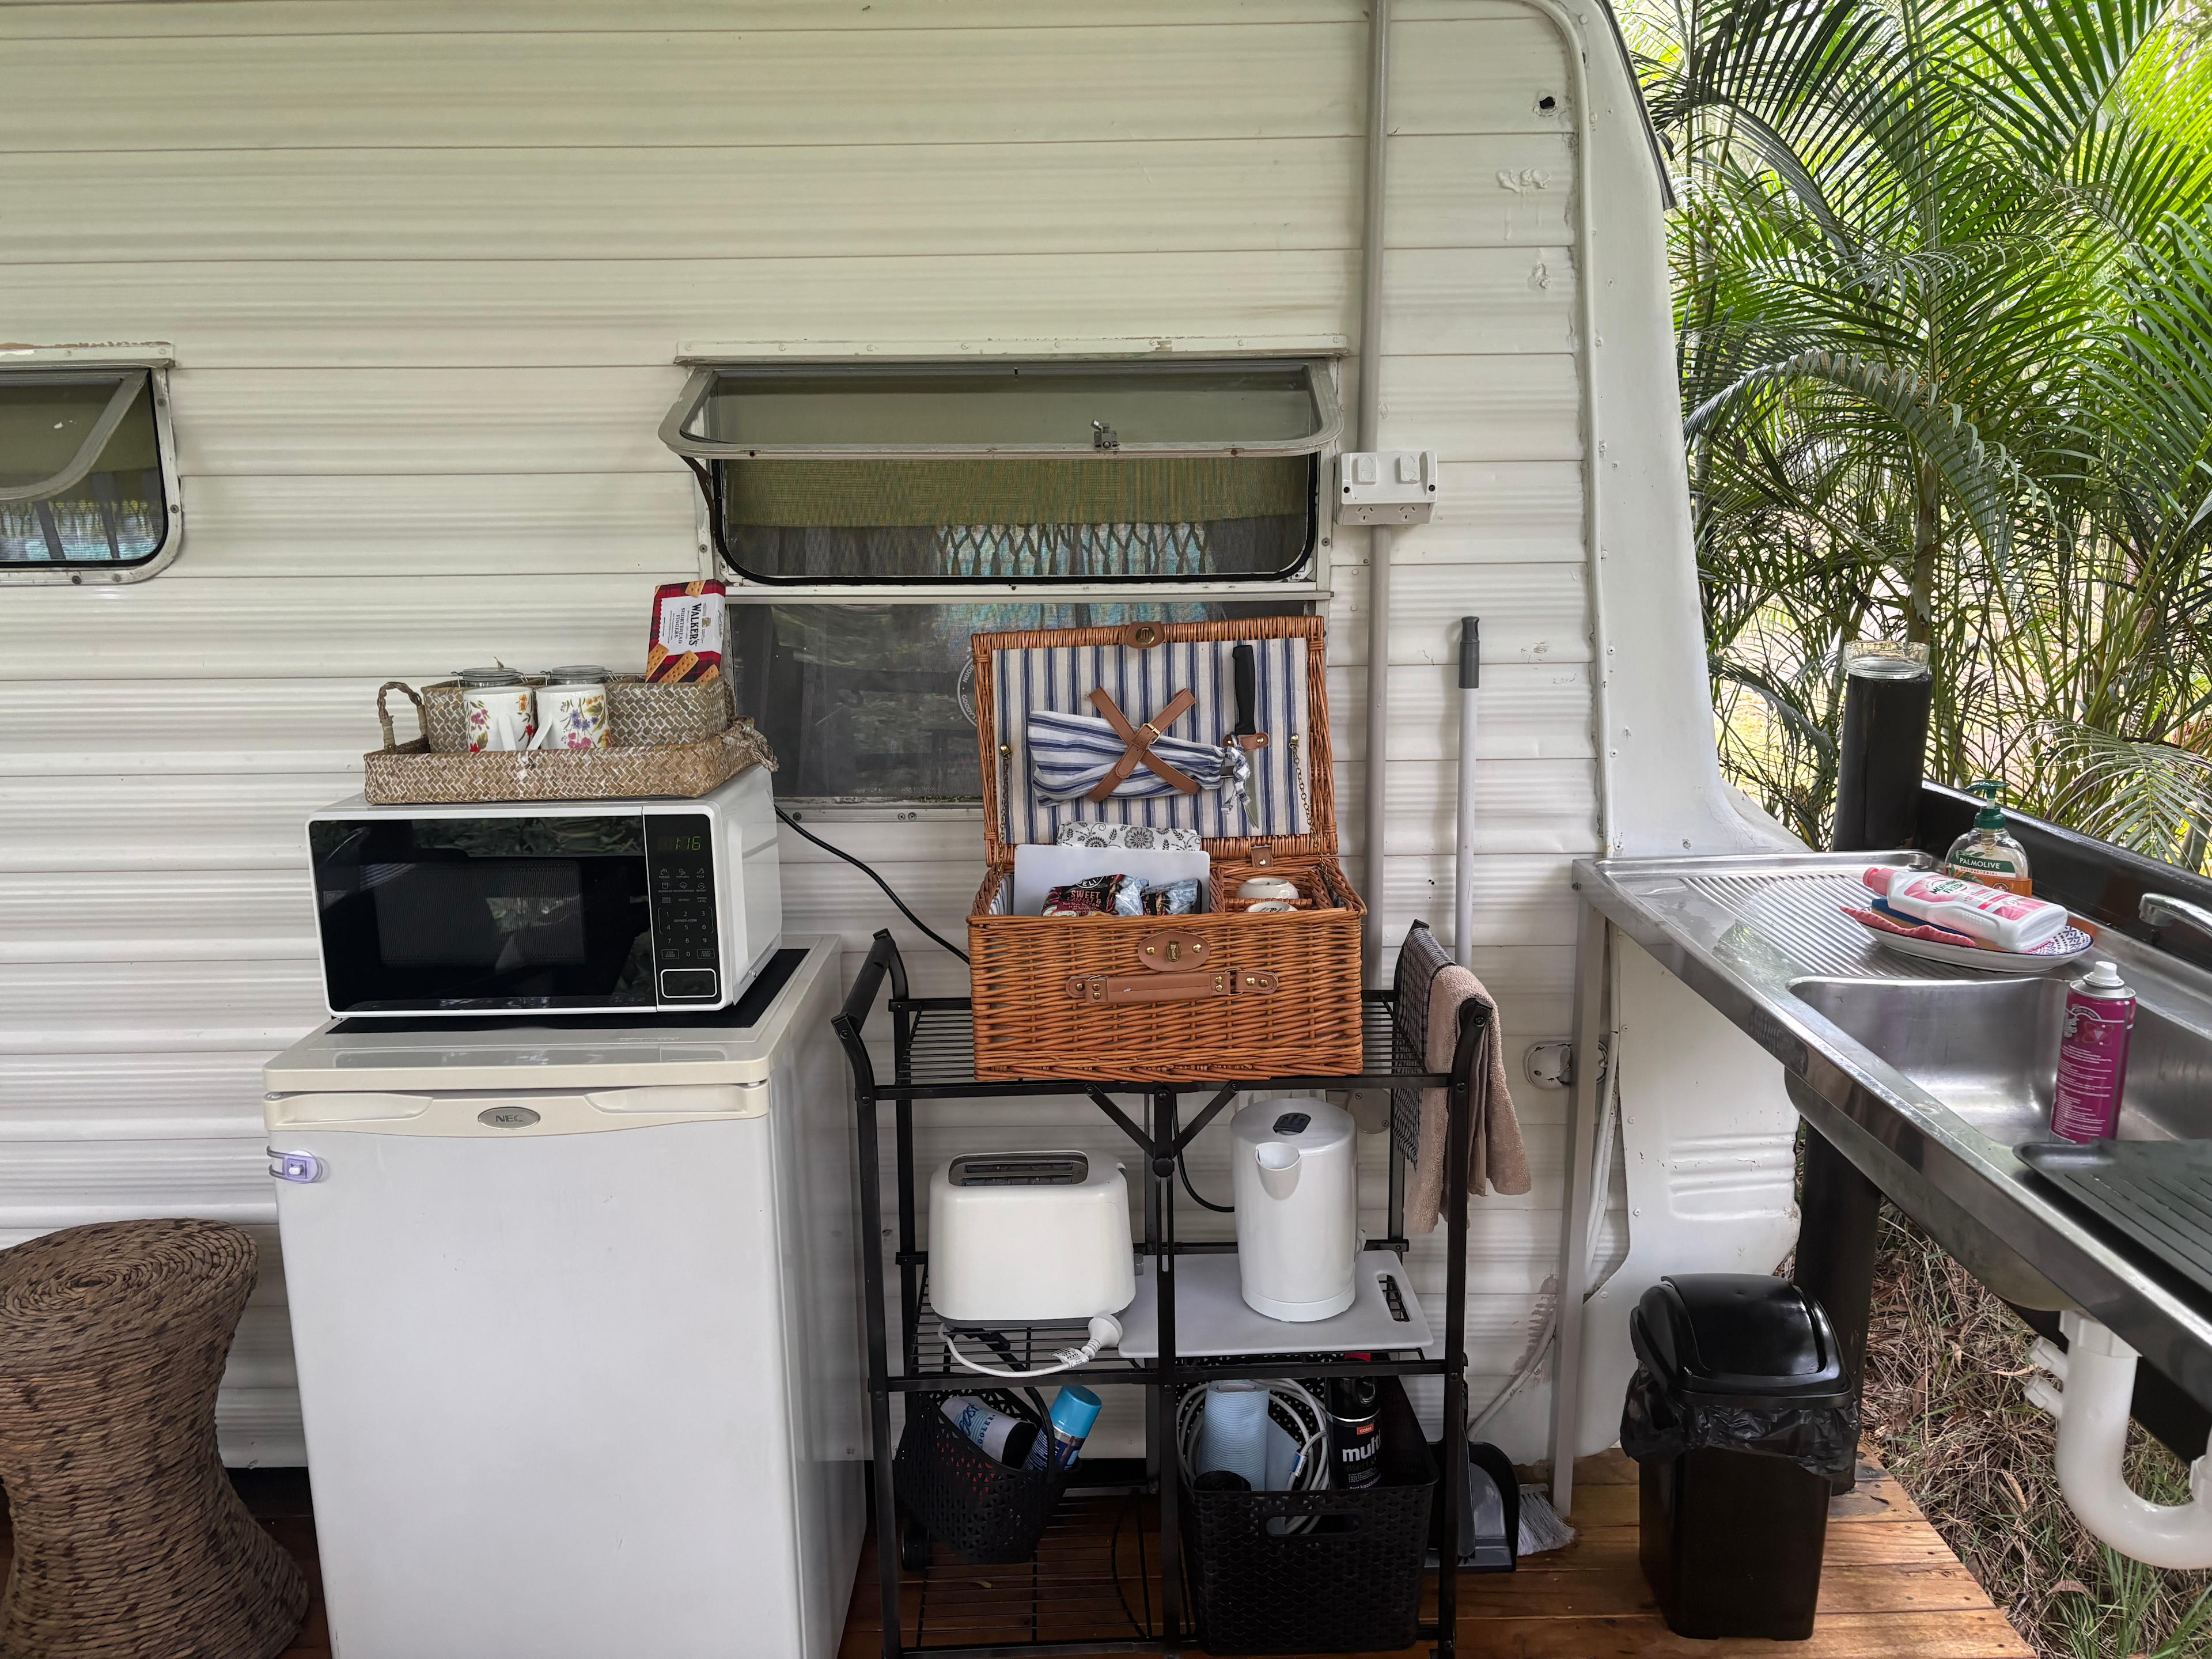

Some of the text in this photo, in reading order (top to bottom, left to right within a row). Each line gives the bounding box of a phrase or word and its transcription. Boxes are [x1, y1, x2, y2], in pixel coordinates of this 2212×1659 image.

[689, 603, 702, 646] WALKER'S
[676, 836, 701, 851] 1:16
[1959, 857, 2001, 869] PALMOLIVE
[1071, 890, 1101, 899] SWEET
